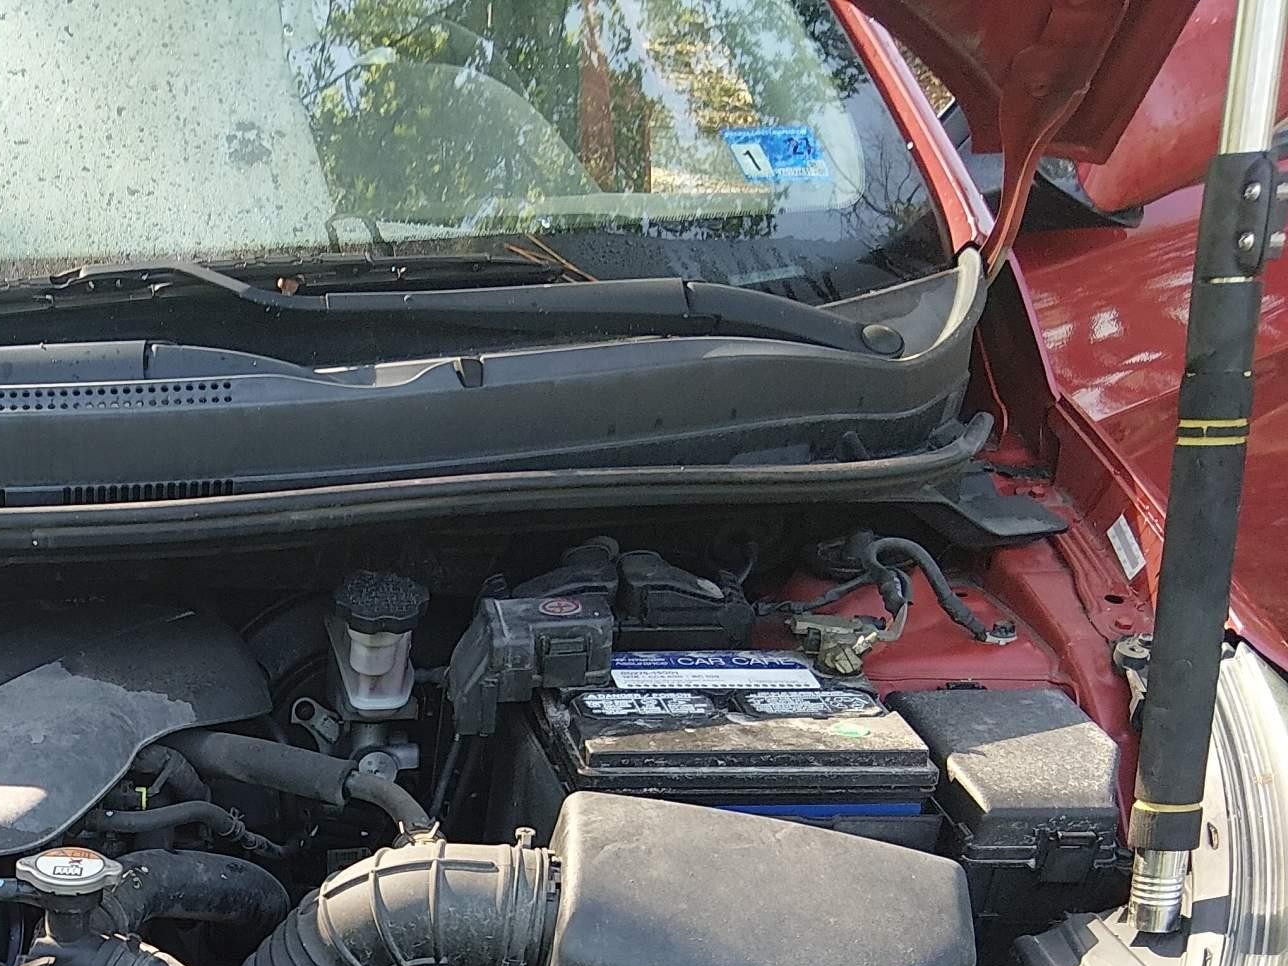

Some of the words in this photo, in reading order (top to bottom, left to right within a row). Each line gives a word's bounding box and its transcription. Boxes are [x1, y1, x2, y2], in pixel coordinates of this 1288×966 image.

[743, 149, 762, 171] 1
[676, 657, 725, 666] CAR
[731, 656, 796, 666] CARE
